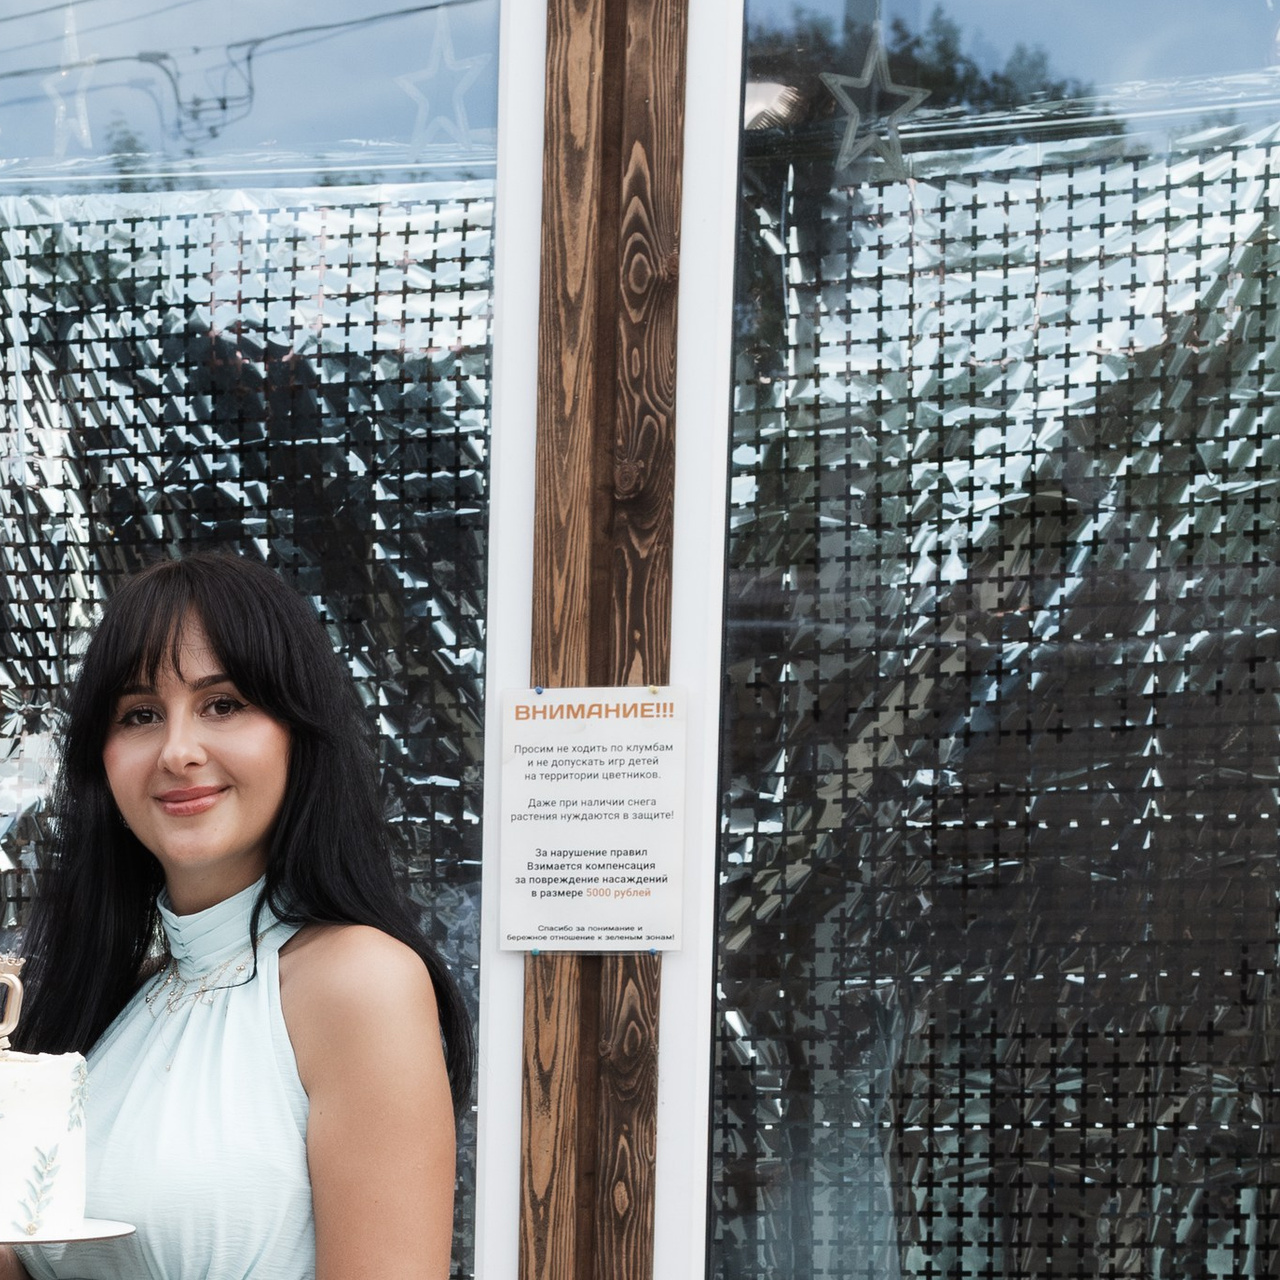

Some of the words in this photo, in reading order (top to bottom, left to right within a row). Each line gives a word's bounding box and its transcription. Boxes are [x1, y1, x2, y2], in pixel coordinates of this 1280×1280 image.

[515, 702, 674, 720] ВНИМАНИЕ!!!
[514, 744, 554, 755] Просим
[572, 745, 607, 754] ходить
[611, 744, 623, 752] по
[626, 742, 673, 754] клумбам
[537, 759, 548, 767] не
[551, 759, 605, 768] допускать
[608, 758, 625, 767] игр
[628, 756, 659, 767] детей
[539, 772, 599, 782] территории
[602, 771, 661, 781] цветников.
[528, 799, 556, 808] Даже
[559, 799, 578, 808] при
[581, 799, 624, 807] наличии
[628, 798, 656, 806] снега
[511, 812, 558, 822] растения
[561, 812, 620, 822] нуждаются
[632, 811, 674, 821] защите!
[535, 849, 547, 857] За
[550, 849, 607, 858] нарушение
[610, 849, 648, 858] правил
[527, 862, 582, 870] Взимается
[586, 862, 656, 871] компенсация
[529, 875, 599, 885] повреждение
[602, 874, 668, 884] насаждений
[540, 889, 583, 899] размере
[586, 888, 611, 897] 5000
[614, 888, 651, 898] рублей
